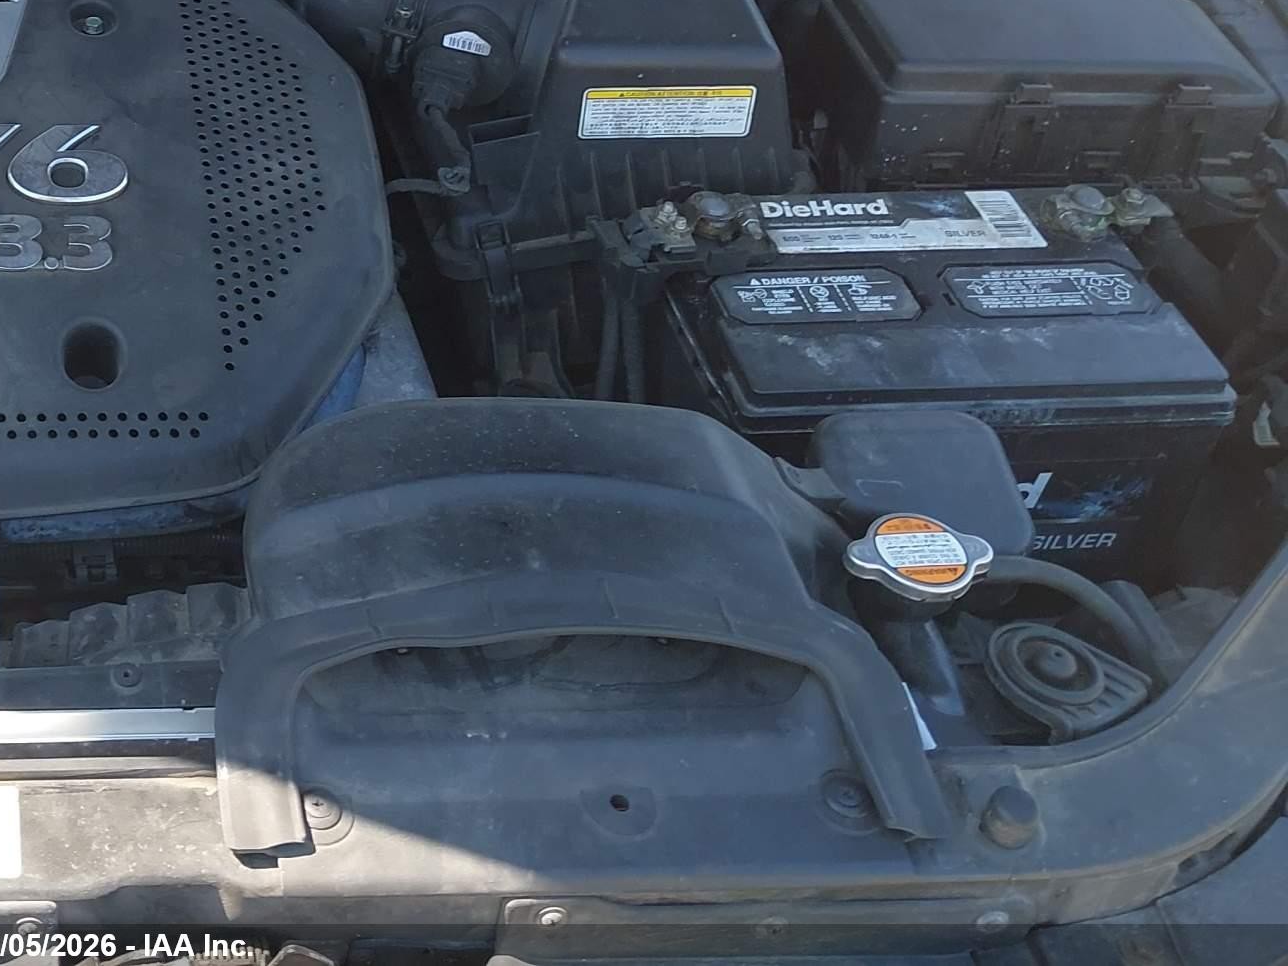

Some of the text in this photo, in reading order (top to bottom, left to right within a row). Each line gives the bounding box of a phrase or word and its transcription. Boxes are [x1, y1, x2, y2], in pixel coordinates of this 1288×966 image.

[759, 199, 889, 218] DieHard
[761, 276, 811, 286] DANGER
[822, 274, 867, 284] POISON
[1033, 533, 1117, 550] SILVER
